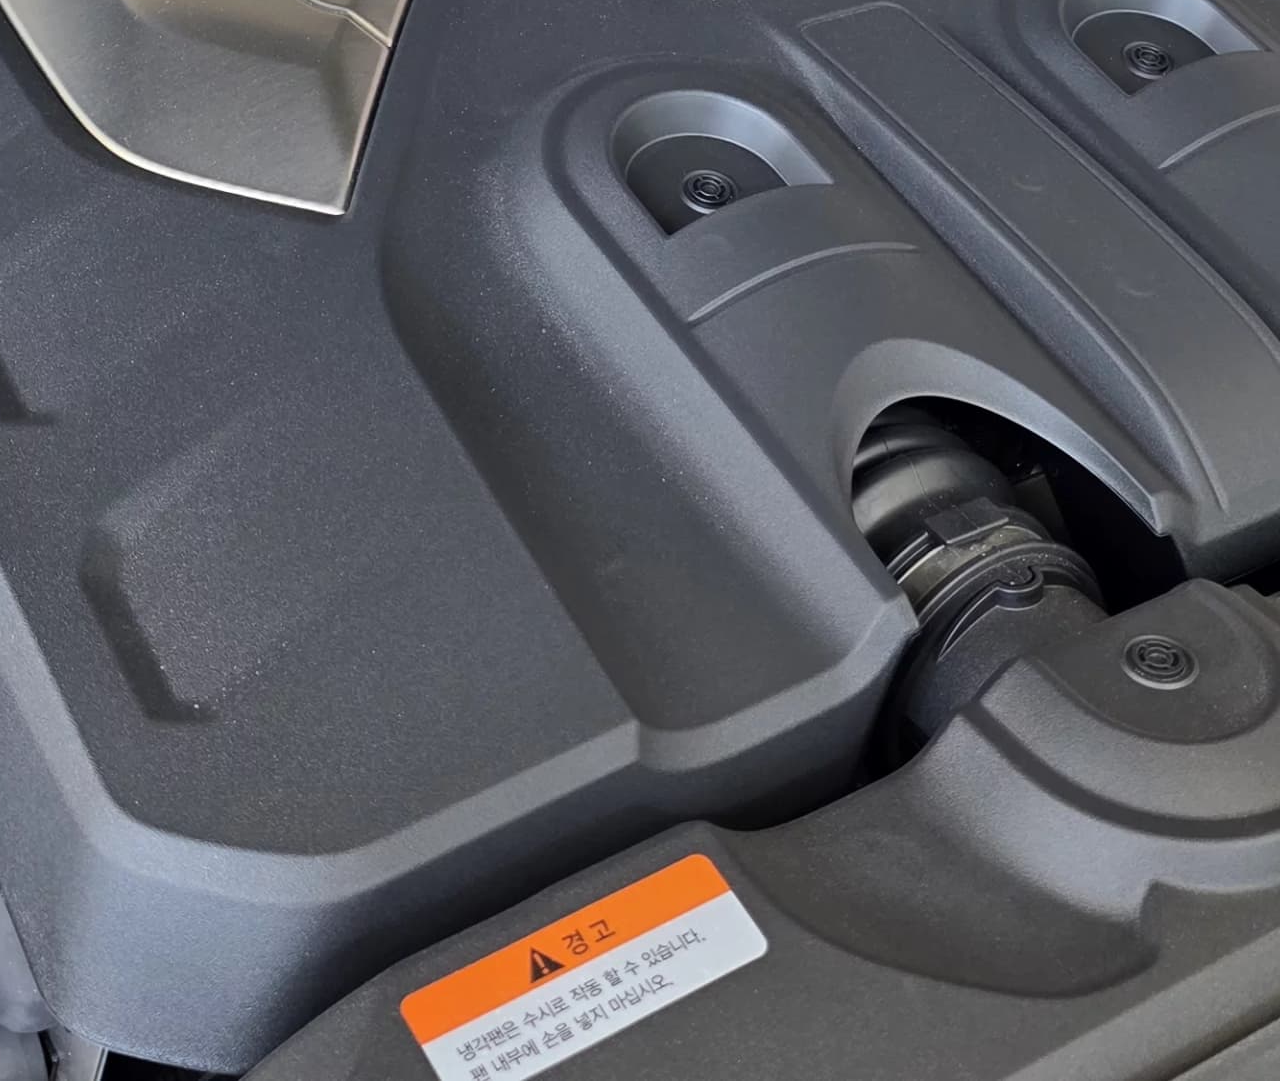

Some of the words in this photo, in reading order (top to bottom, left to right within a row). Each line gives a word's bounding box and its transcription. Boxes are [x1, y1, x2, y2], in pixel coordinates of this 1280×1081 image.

[561, 918, 617, 956] 경고
[456, 1020, 521, 1062] 냉각팬은
[522, 996, 571, 1028] 수시로
[569, 978, 603, 1002] 작동
[602, 967, 624, 987] 할
[623, 960, 640, 976] 수
[640, 928, 707, 968] 있습니다.
[490, 1038, 541, 1072] 내부에
[541, 1022, 575, 1050] 손을
[573, 1003, 609, 1031] 넣지
